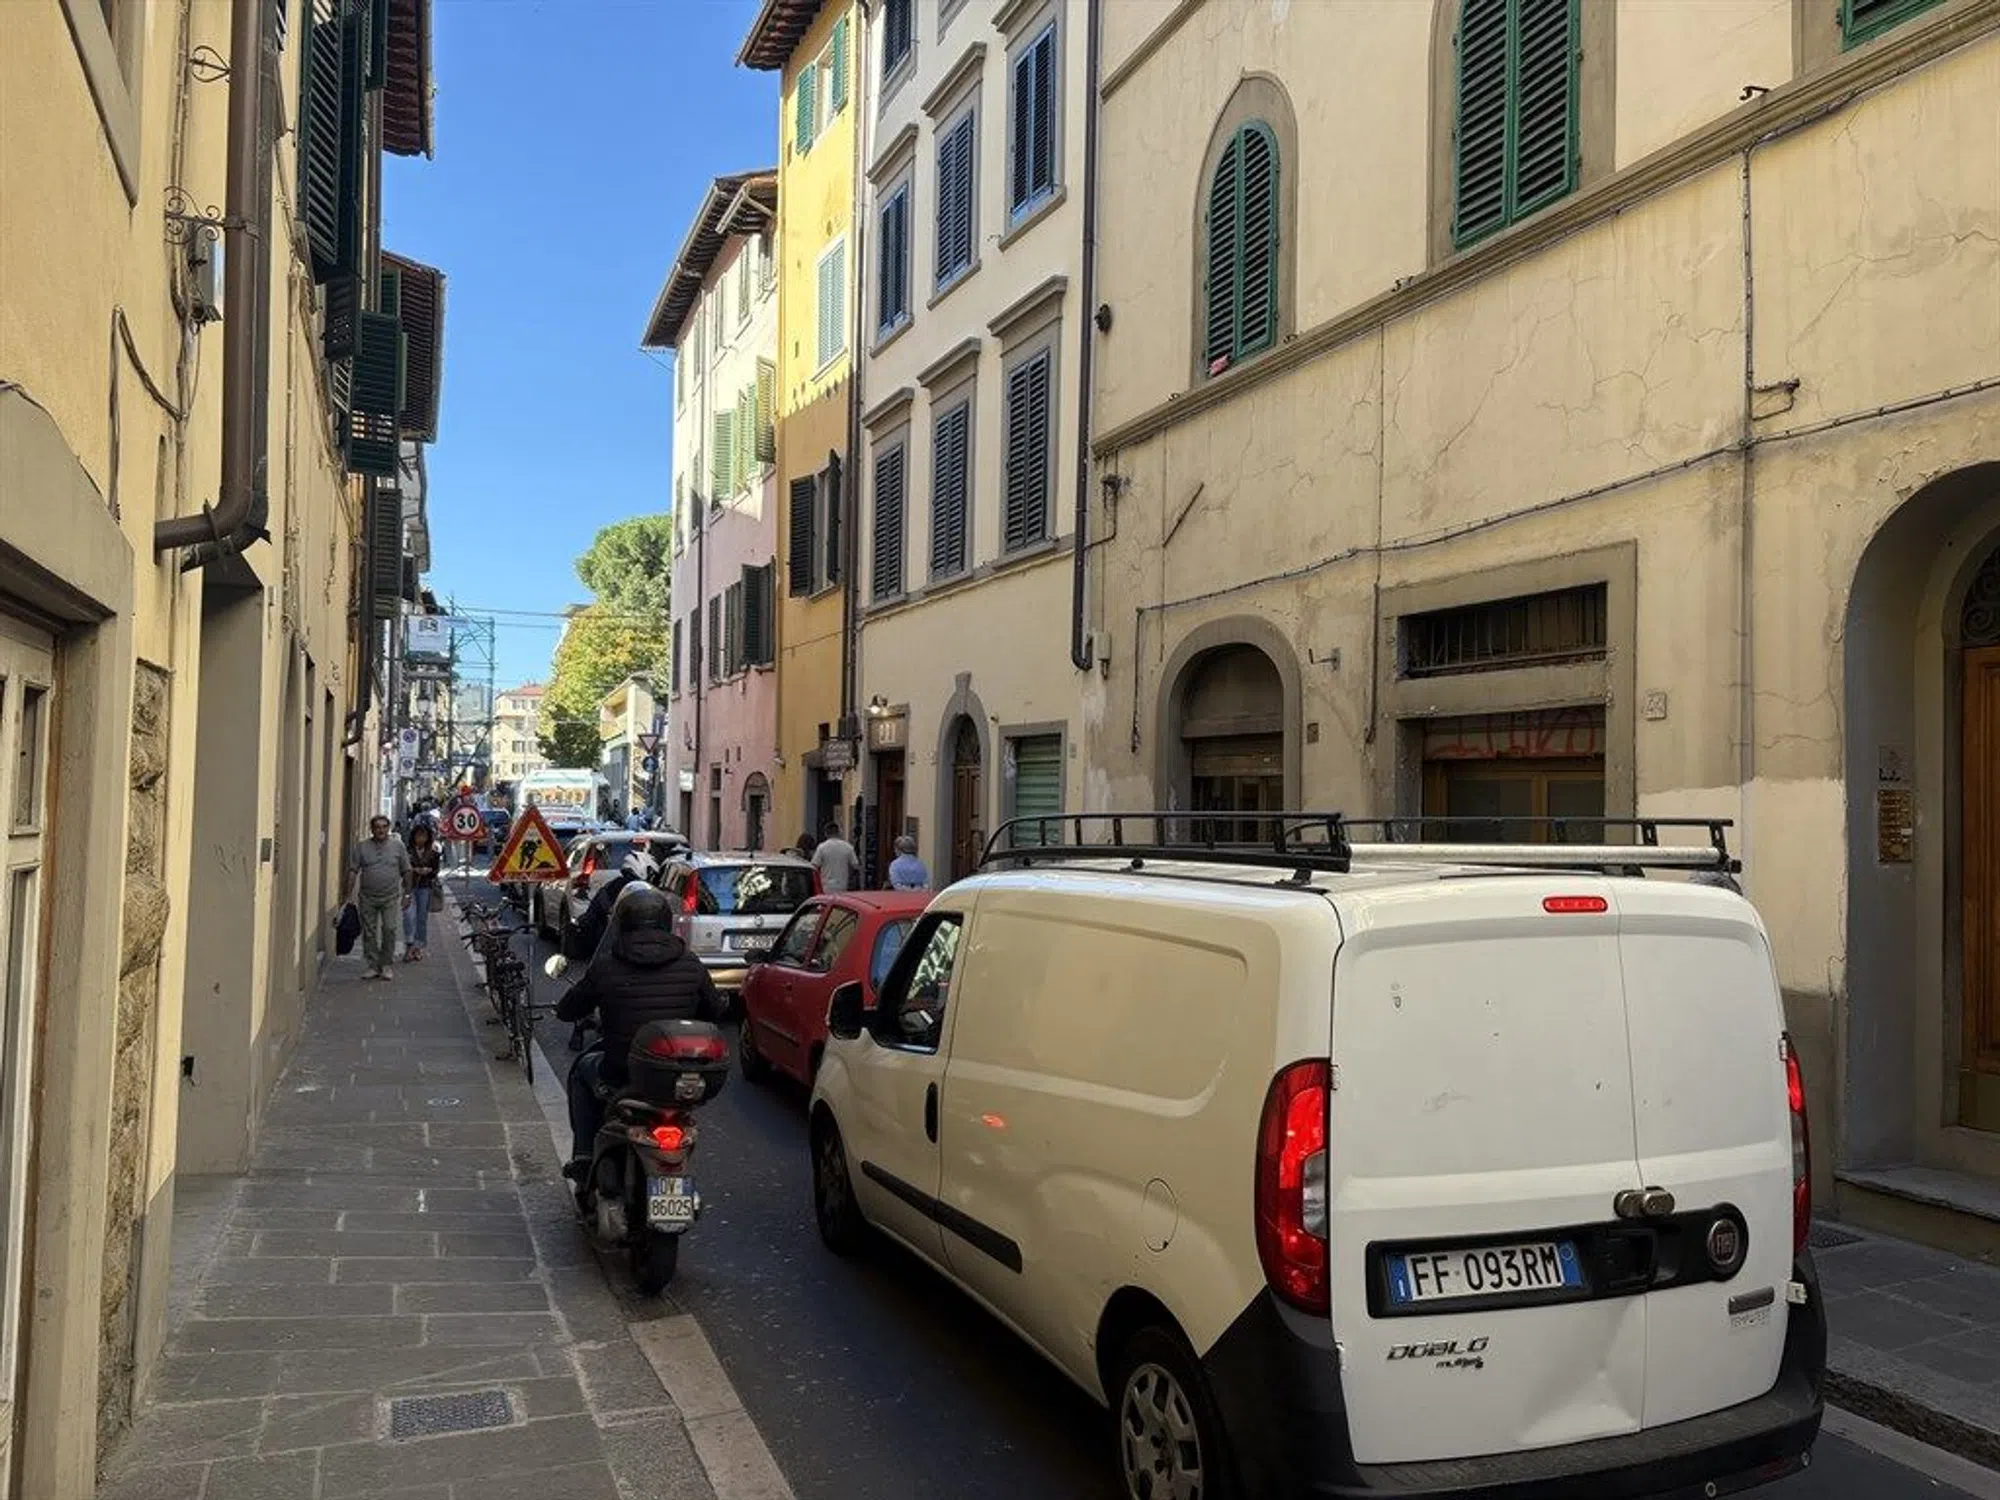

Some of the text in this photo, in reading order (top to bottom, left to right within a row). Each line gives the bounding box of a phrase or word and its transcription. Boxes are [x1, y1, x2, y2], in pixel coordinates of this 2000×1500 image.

[456, 812, 477, 830] 30
[652, 1199, 691, 1216] 86025
[1410, 1255, 1449, 1296] FF
[1463, 1246, 1562, 1291] 093RM
